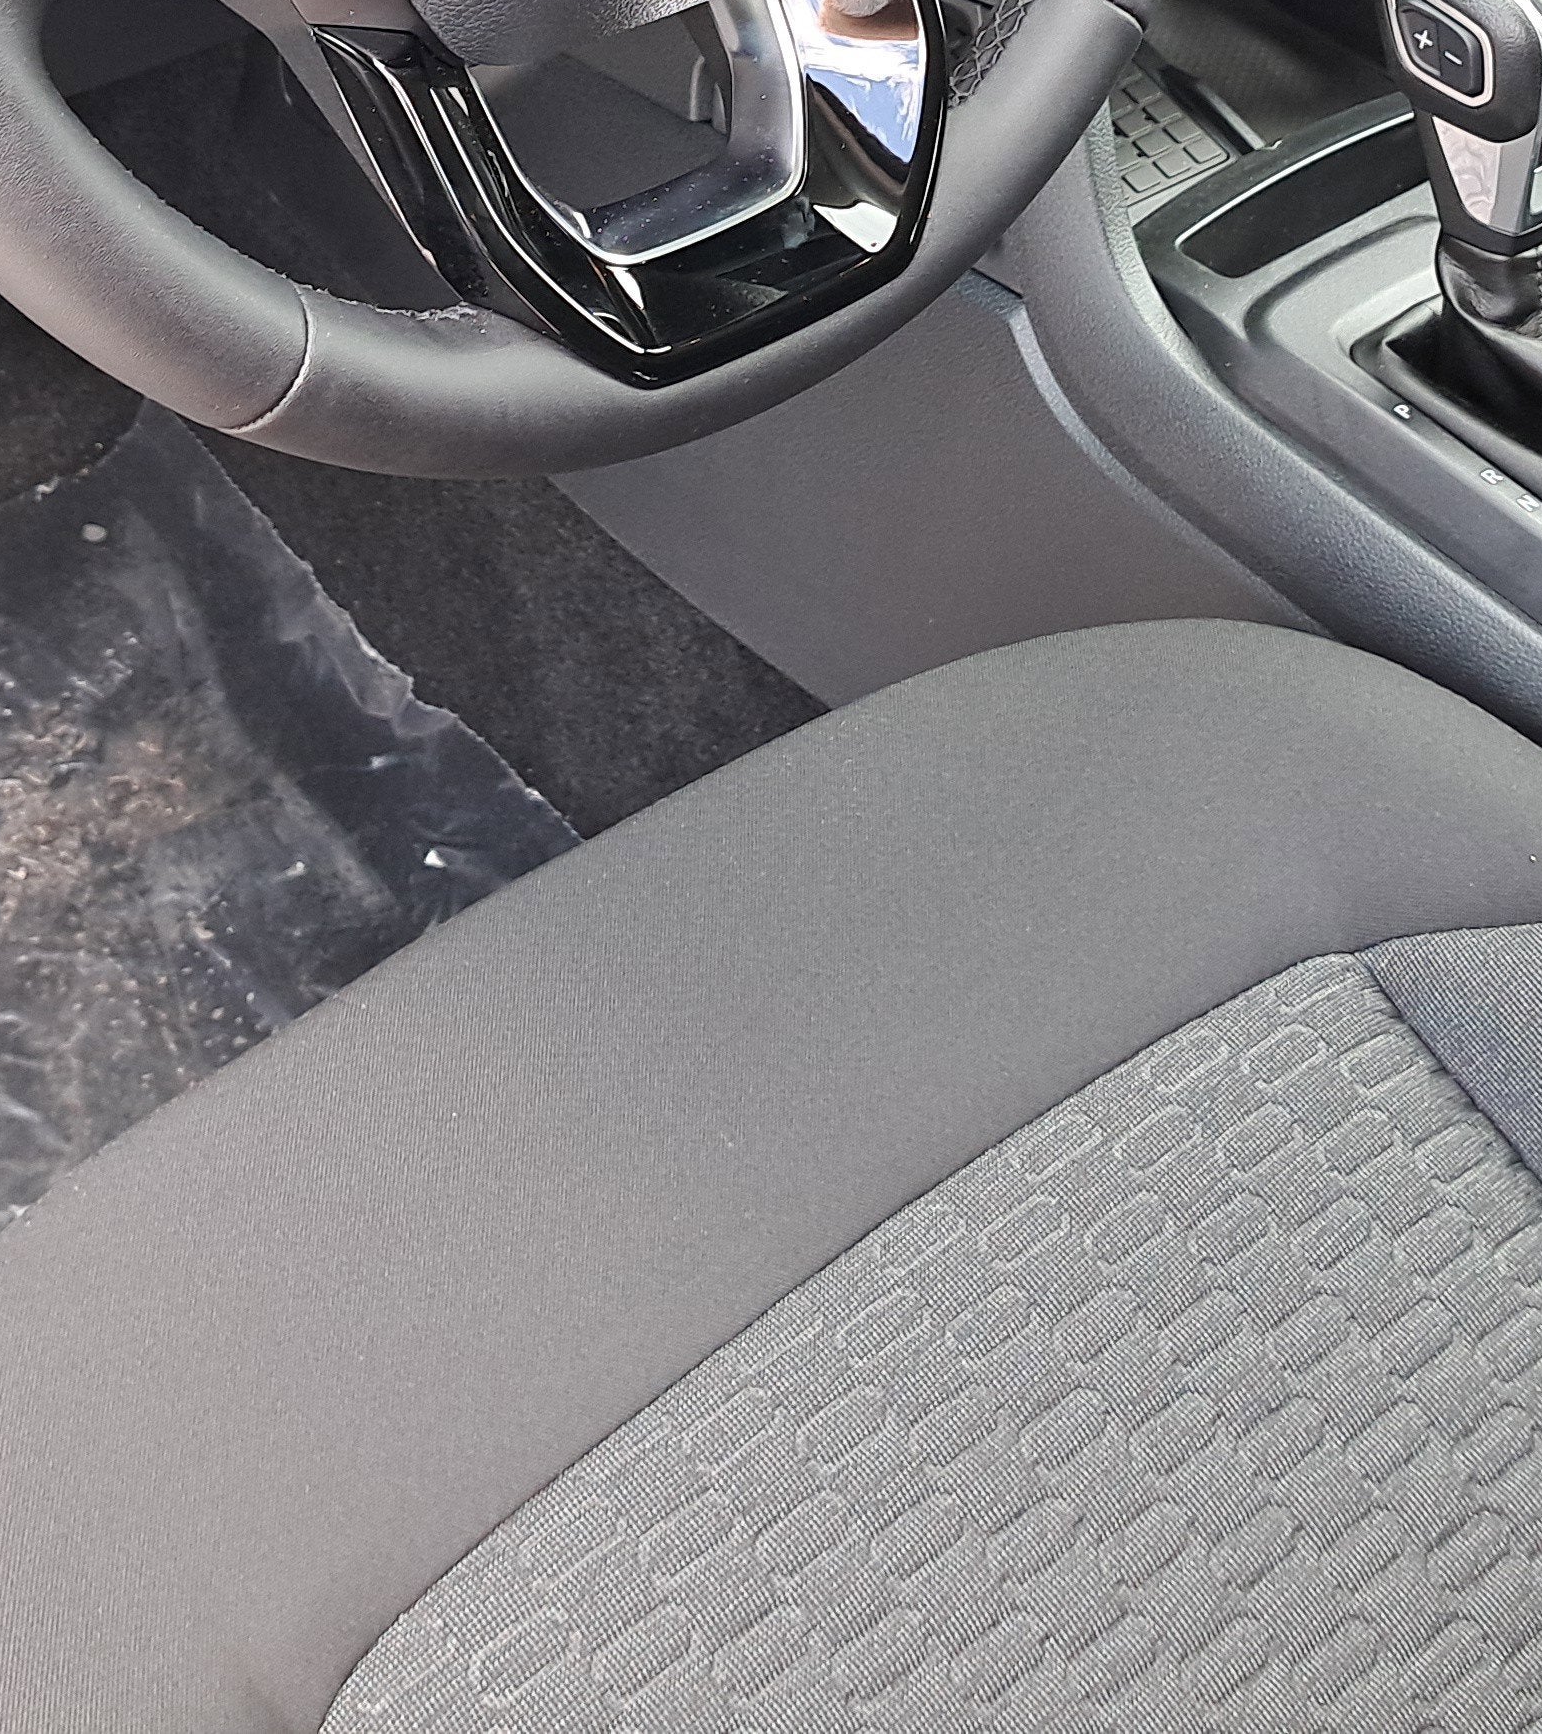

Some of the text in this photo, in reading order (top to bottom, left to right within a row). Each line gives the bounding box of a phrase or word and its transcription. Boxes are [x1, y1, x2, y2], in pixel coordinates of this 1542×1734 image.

[1393, 402, 1412, 420] P
[1481, 468, 1504, 486] R
[1517, 495, 1541, 514] N
